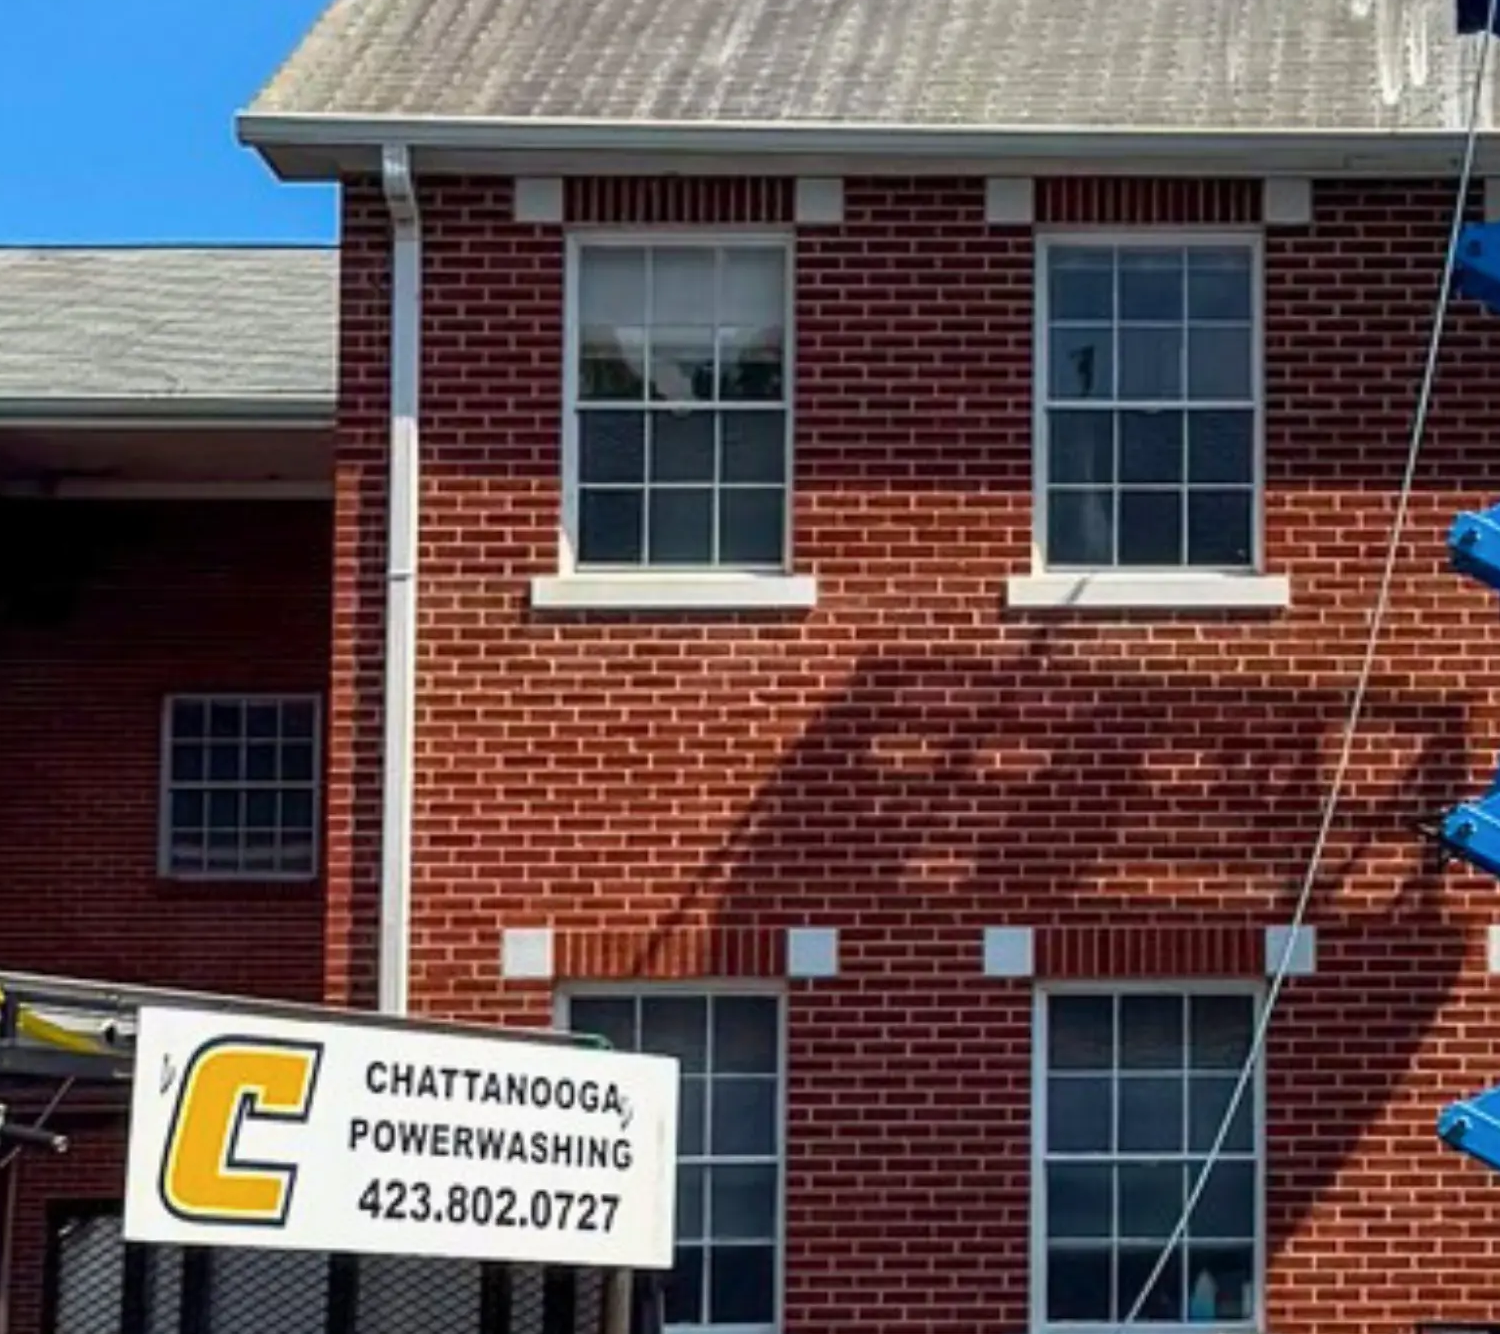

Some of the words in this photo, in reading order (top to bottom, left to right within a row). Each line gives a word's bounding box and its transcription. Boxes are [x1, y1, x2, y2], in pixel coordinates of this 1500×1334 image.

[365, 1061, 623, 1114] CHATTANOOGA
[348, 1118, 633, 1170] POWERWASHING
[358, 1178, 621, 1233] 423.802.0727
